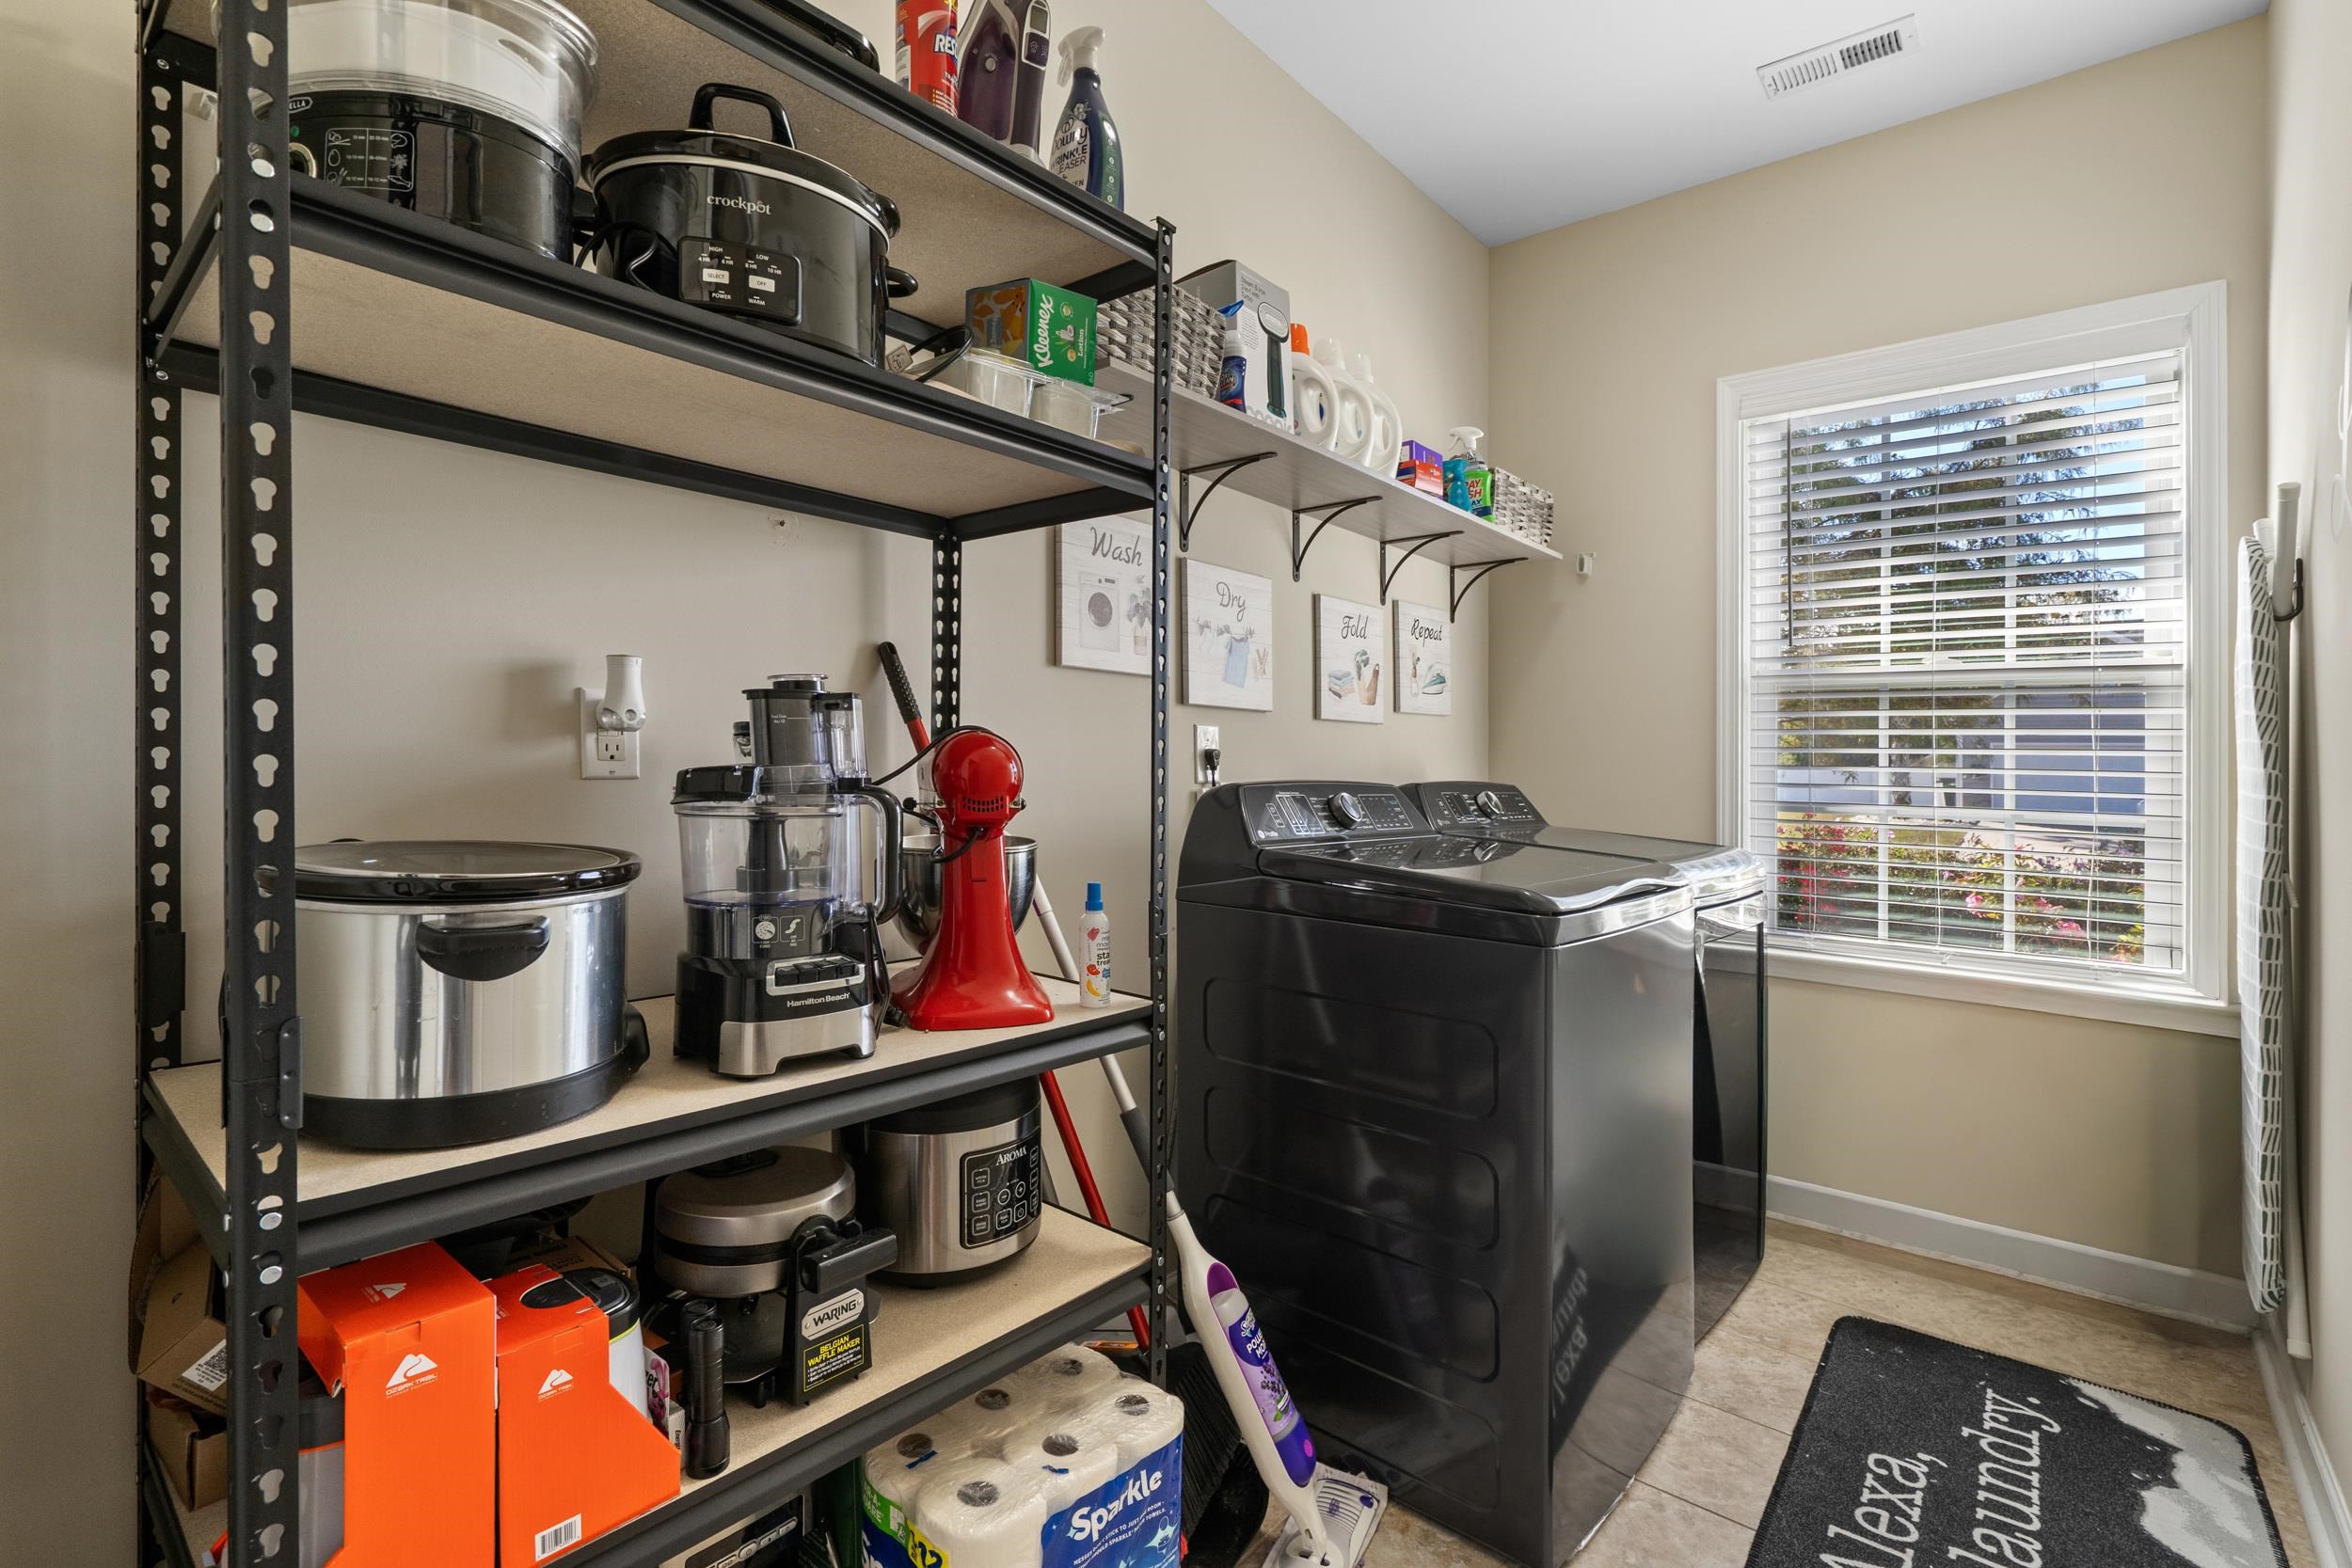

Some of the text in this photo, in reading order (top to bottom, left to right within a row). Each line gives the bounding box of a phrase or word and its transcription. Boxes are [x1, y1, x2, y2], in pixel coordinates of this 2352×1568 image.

[934, 34, 958, 58] RES
[289, 100, 307, 109] ELLA
[707, 195, 771, 215] crockpot
[1033, 293, 1055, 368] Kleenex
[1090, 527, 1142, 566] Wash
[1216, 581, 1247, 622] Dry
[1341, 613, 1369, 639] Fold
[1411, 618, 1443, 647] Repeat
[1096, 952, 1110, 960] sta
[787, 992, 850, 1007] Hamilton Beach
[995, 1146, 1027, 1166] AROMA
[812, 1299, 857, 1327] WARING
[807, 1337, 861, 1367] WAFFLE MAKER
[820, 1335, 850, 1354] BELGIAN
[1247, 1327, 1263, 1354] POWE
[414, 1373, 437, 1386] TRAIL
[1947, 1388, 2062, 1568] laundry.
[1071, 1469, 1163, 1543] Sparkle
[1120, 1523, 1127, 1531] TO
[1127, 1517, 1139, 1529] JUST
[1147, 1501, 1162, 1513] ROOM
[1108, 1531, 1133, 1546] SPARKLE
